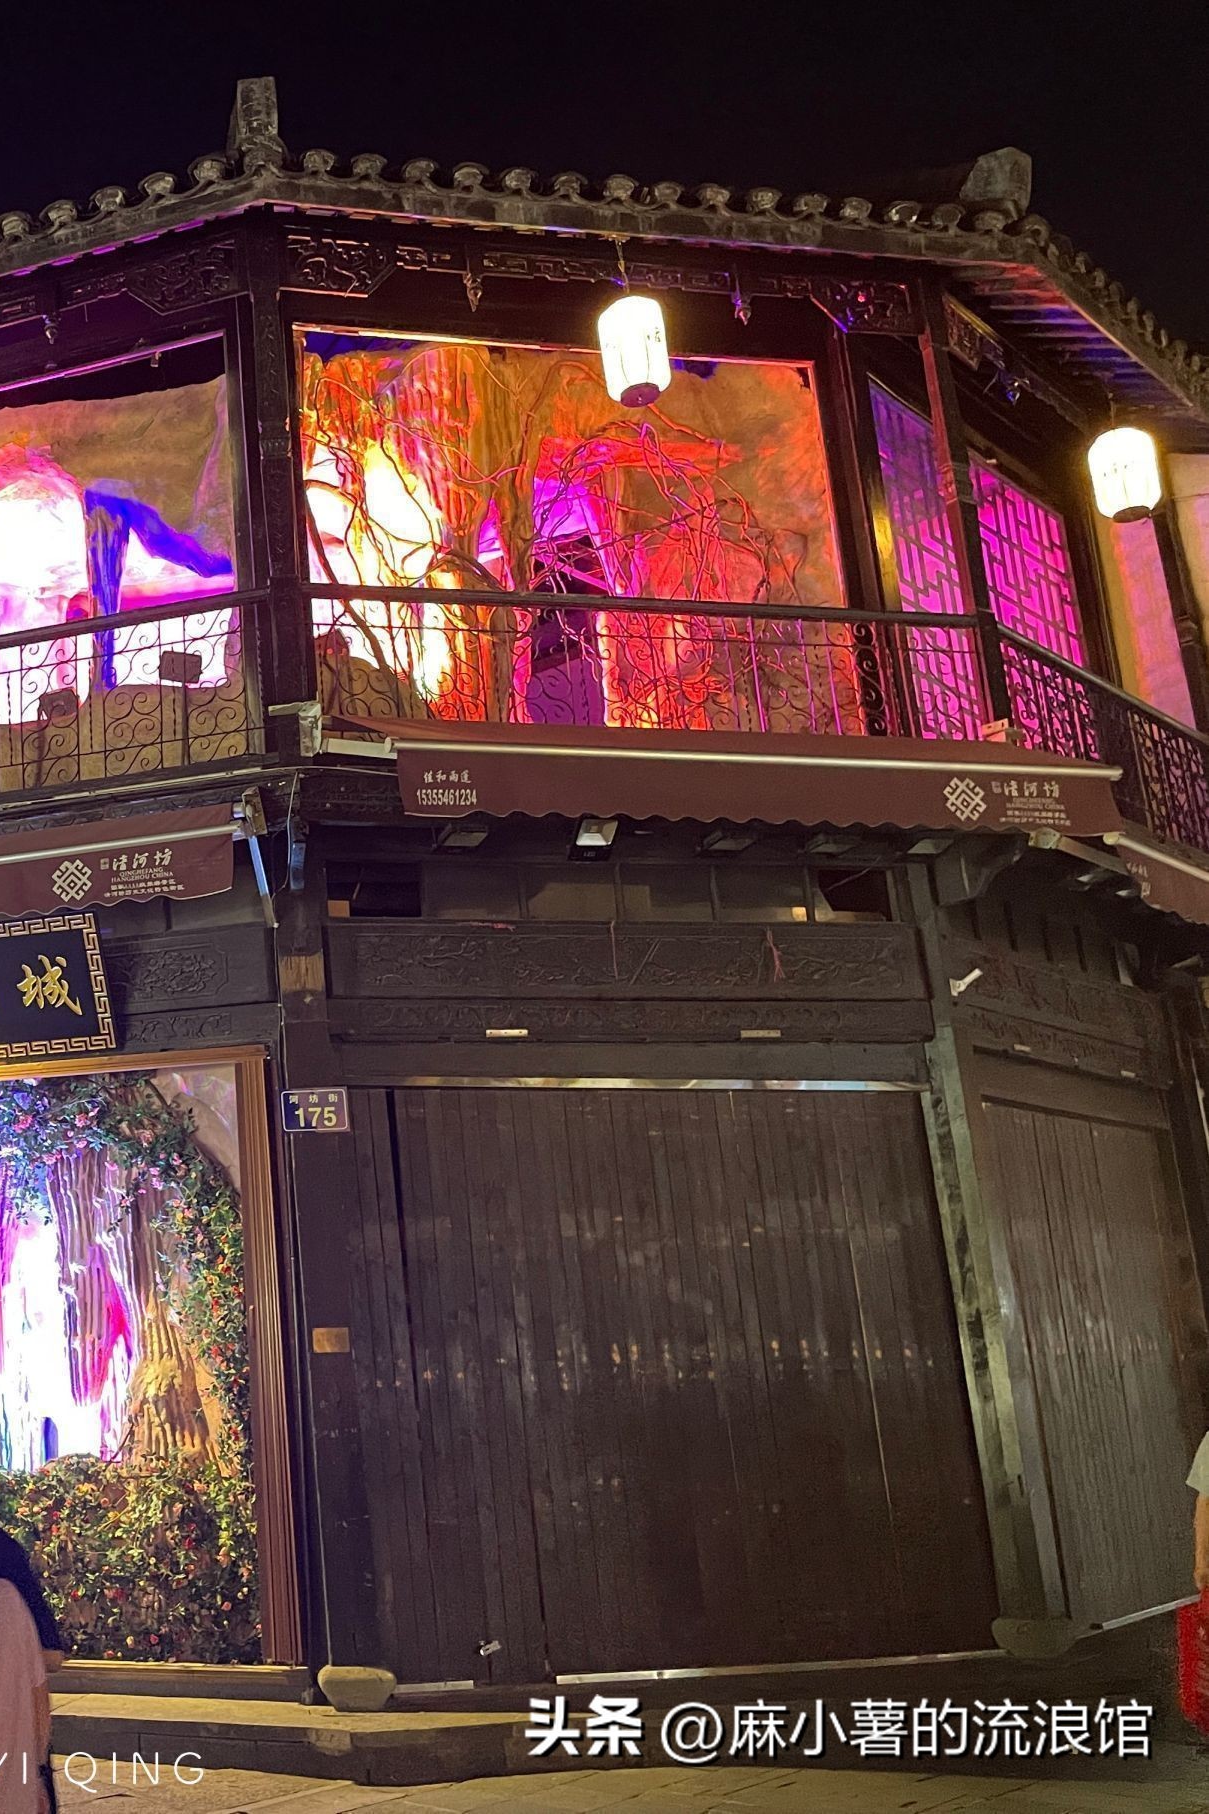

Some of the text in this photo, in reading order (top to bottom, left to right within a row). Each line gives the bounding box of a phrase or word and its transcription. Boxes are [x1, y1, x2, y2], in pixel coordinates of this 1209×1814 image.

[416, 789, 477, 805] 15355461234
[112, 848, 172, 871] 清河坊
[152, 871, 174, 879] CHINA
[288, 1093, 338, 1105] 河坊街
[294, 1106, 337, 1128] 175
